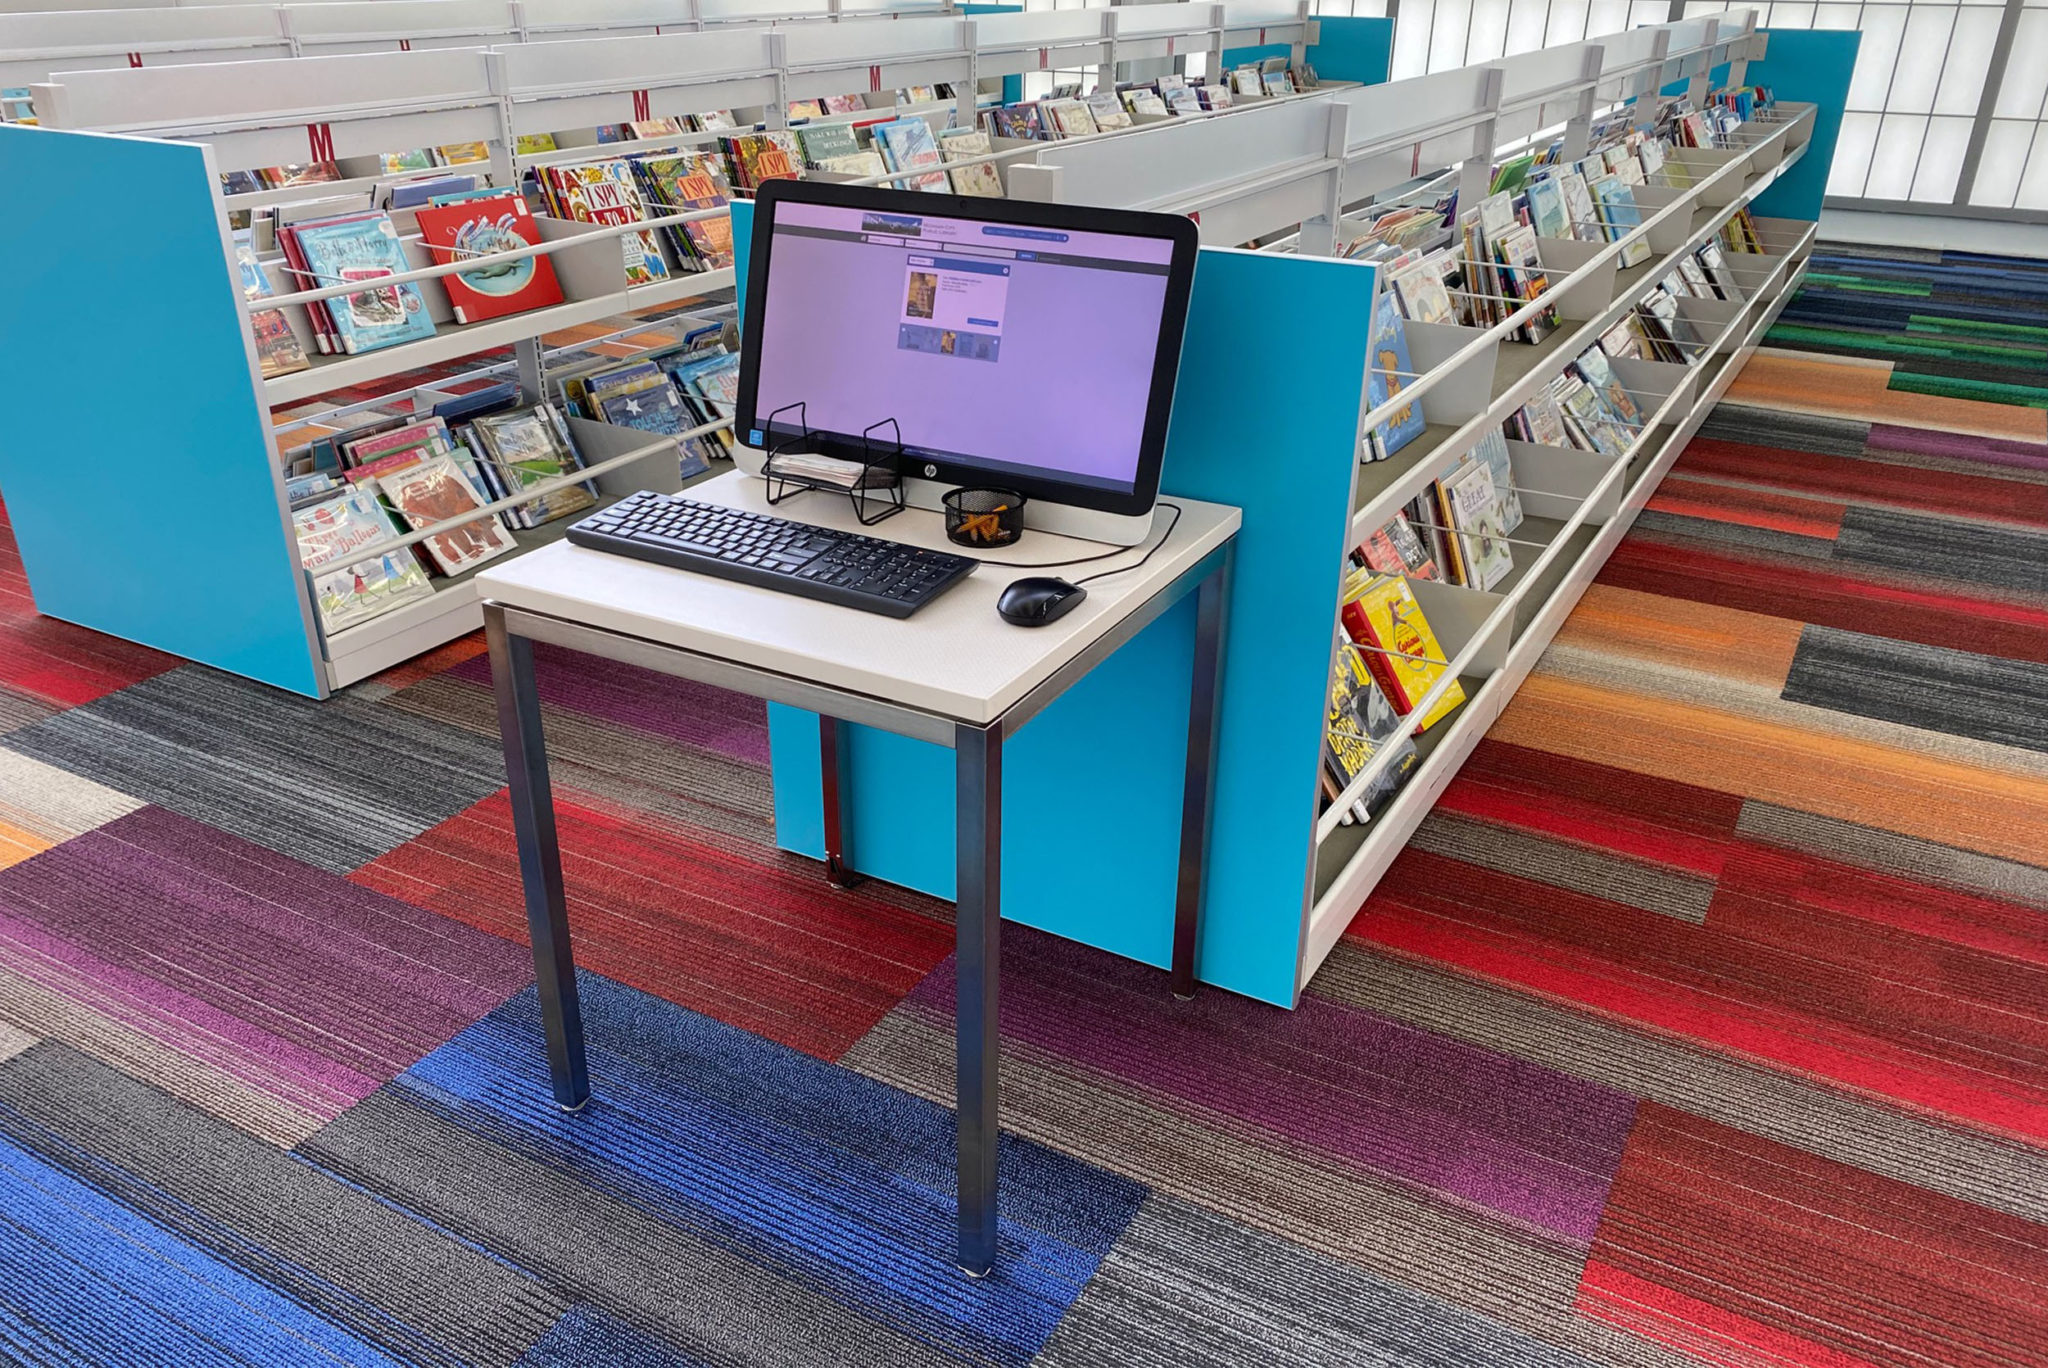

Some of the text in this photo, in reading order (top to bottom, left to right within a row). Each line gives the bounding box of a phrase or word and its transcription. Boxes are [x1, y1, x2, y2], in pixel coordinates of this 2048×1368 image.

[632, 89, 650, 122] M
[307, 123, 336, 163] M
[585, 182, 621, 209] I SPY
[688, 175, 714, 198] SPY
